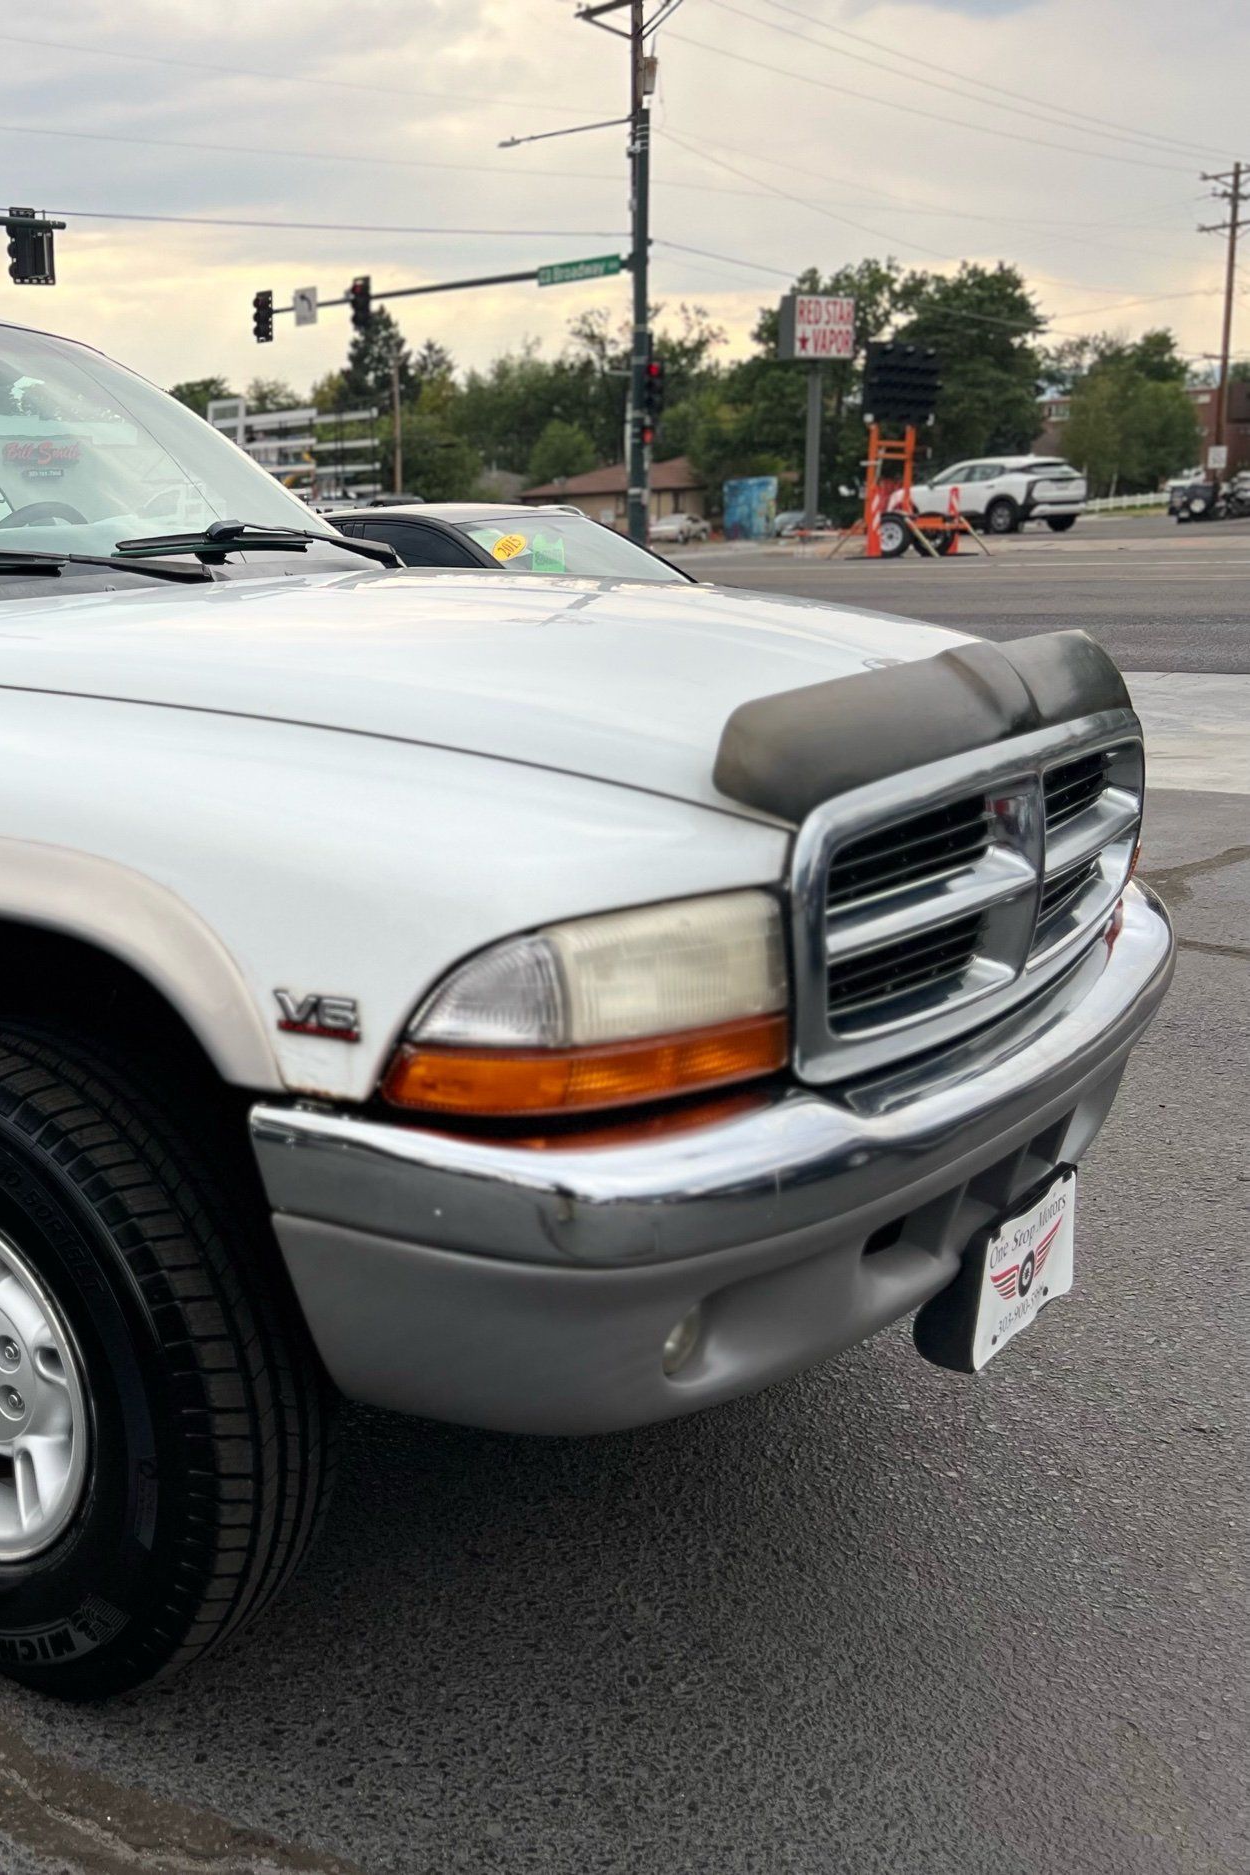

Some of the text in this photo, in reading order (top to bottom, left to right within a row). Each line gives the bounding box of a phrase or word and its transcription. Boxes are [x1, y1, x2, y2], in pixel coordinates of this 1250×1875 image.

[798, 299, 854, 326] RED STAR
[812, 327, 851, 353] VAPOR
[497, 536, 522, 558] 2015
[990, 1193, 1067, 1269] One Stop Motors
